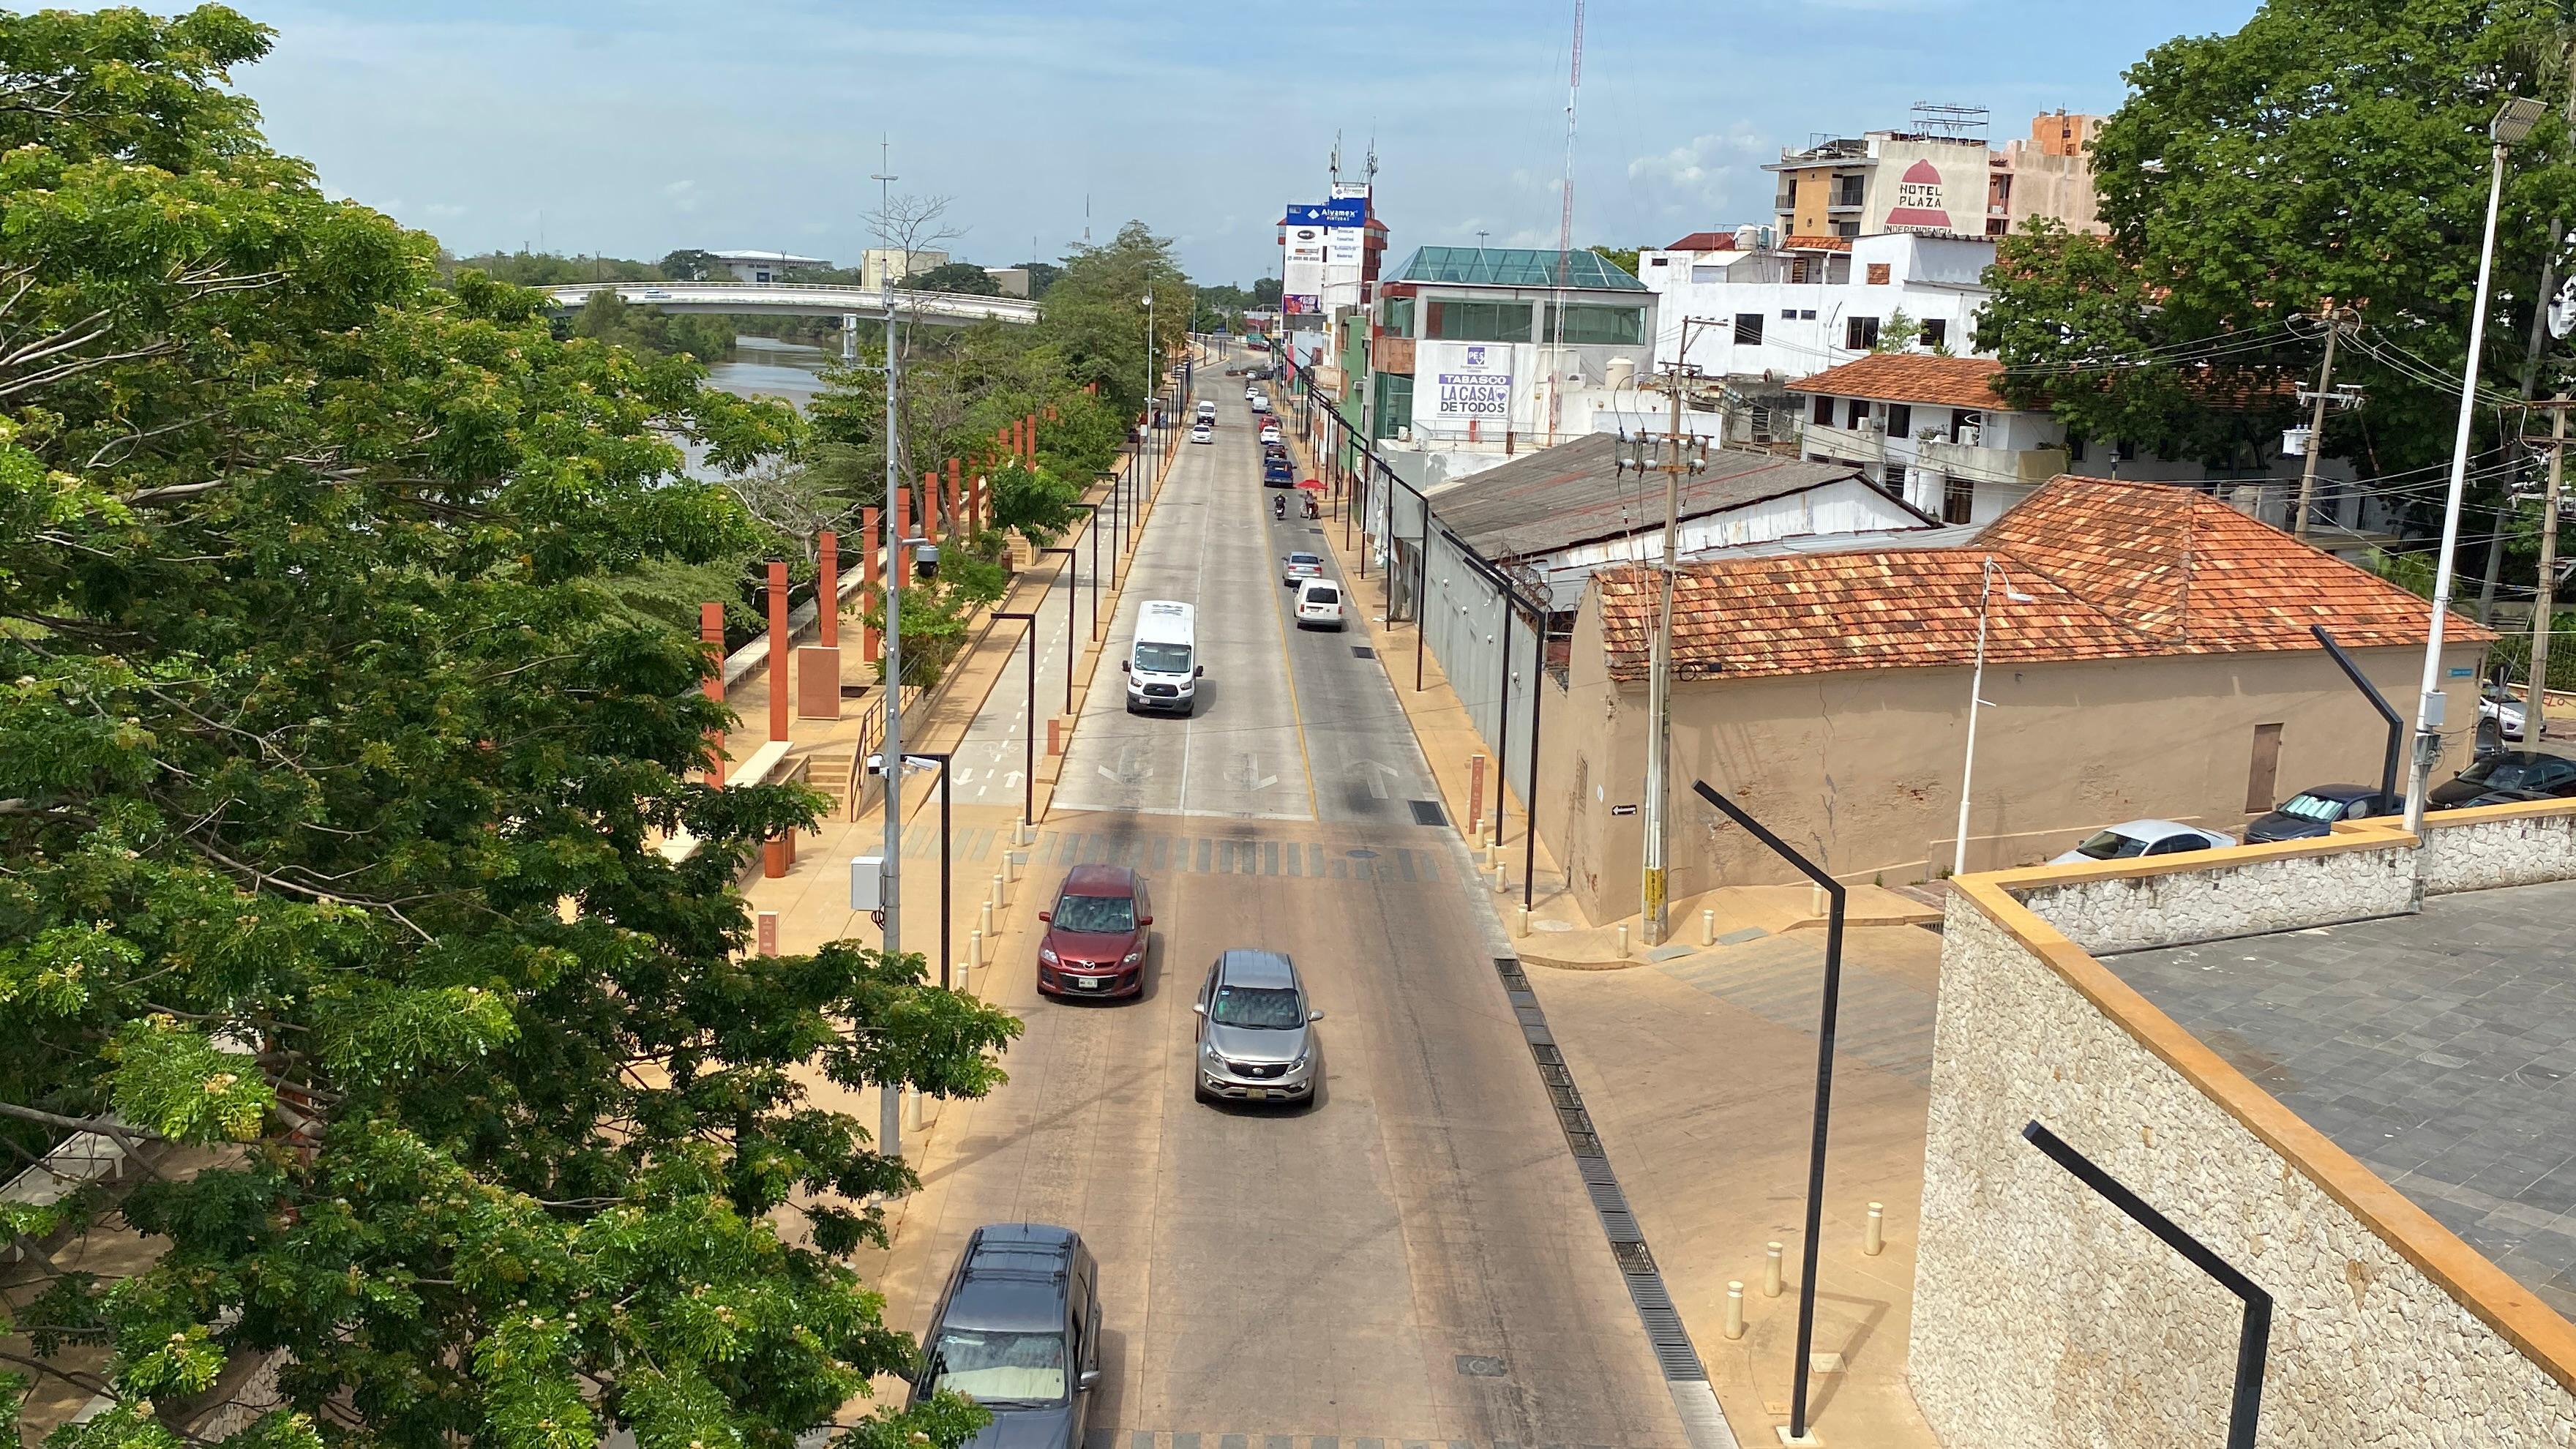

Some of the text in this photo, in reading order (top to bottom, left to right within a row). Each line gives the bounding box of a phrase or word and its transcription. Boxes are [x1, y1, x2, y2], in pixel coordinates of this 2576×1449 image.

[1900, 184, 1942, 196] HOTEL
[1899, 196, 1942, 208] PLAZA
[1321, 209, 1355, 217] Alvamex
[1468, 351, 1484, 360] PES
[1445, 375, 1507, 385] TABASCO
[1441, 386, 1495, 402] LA CASA
[1440, 402, 1505, 413] DE TODOS
